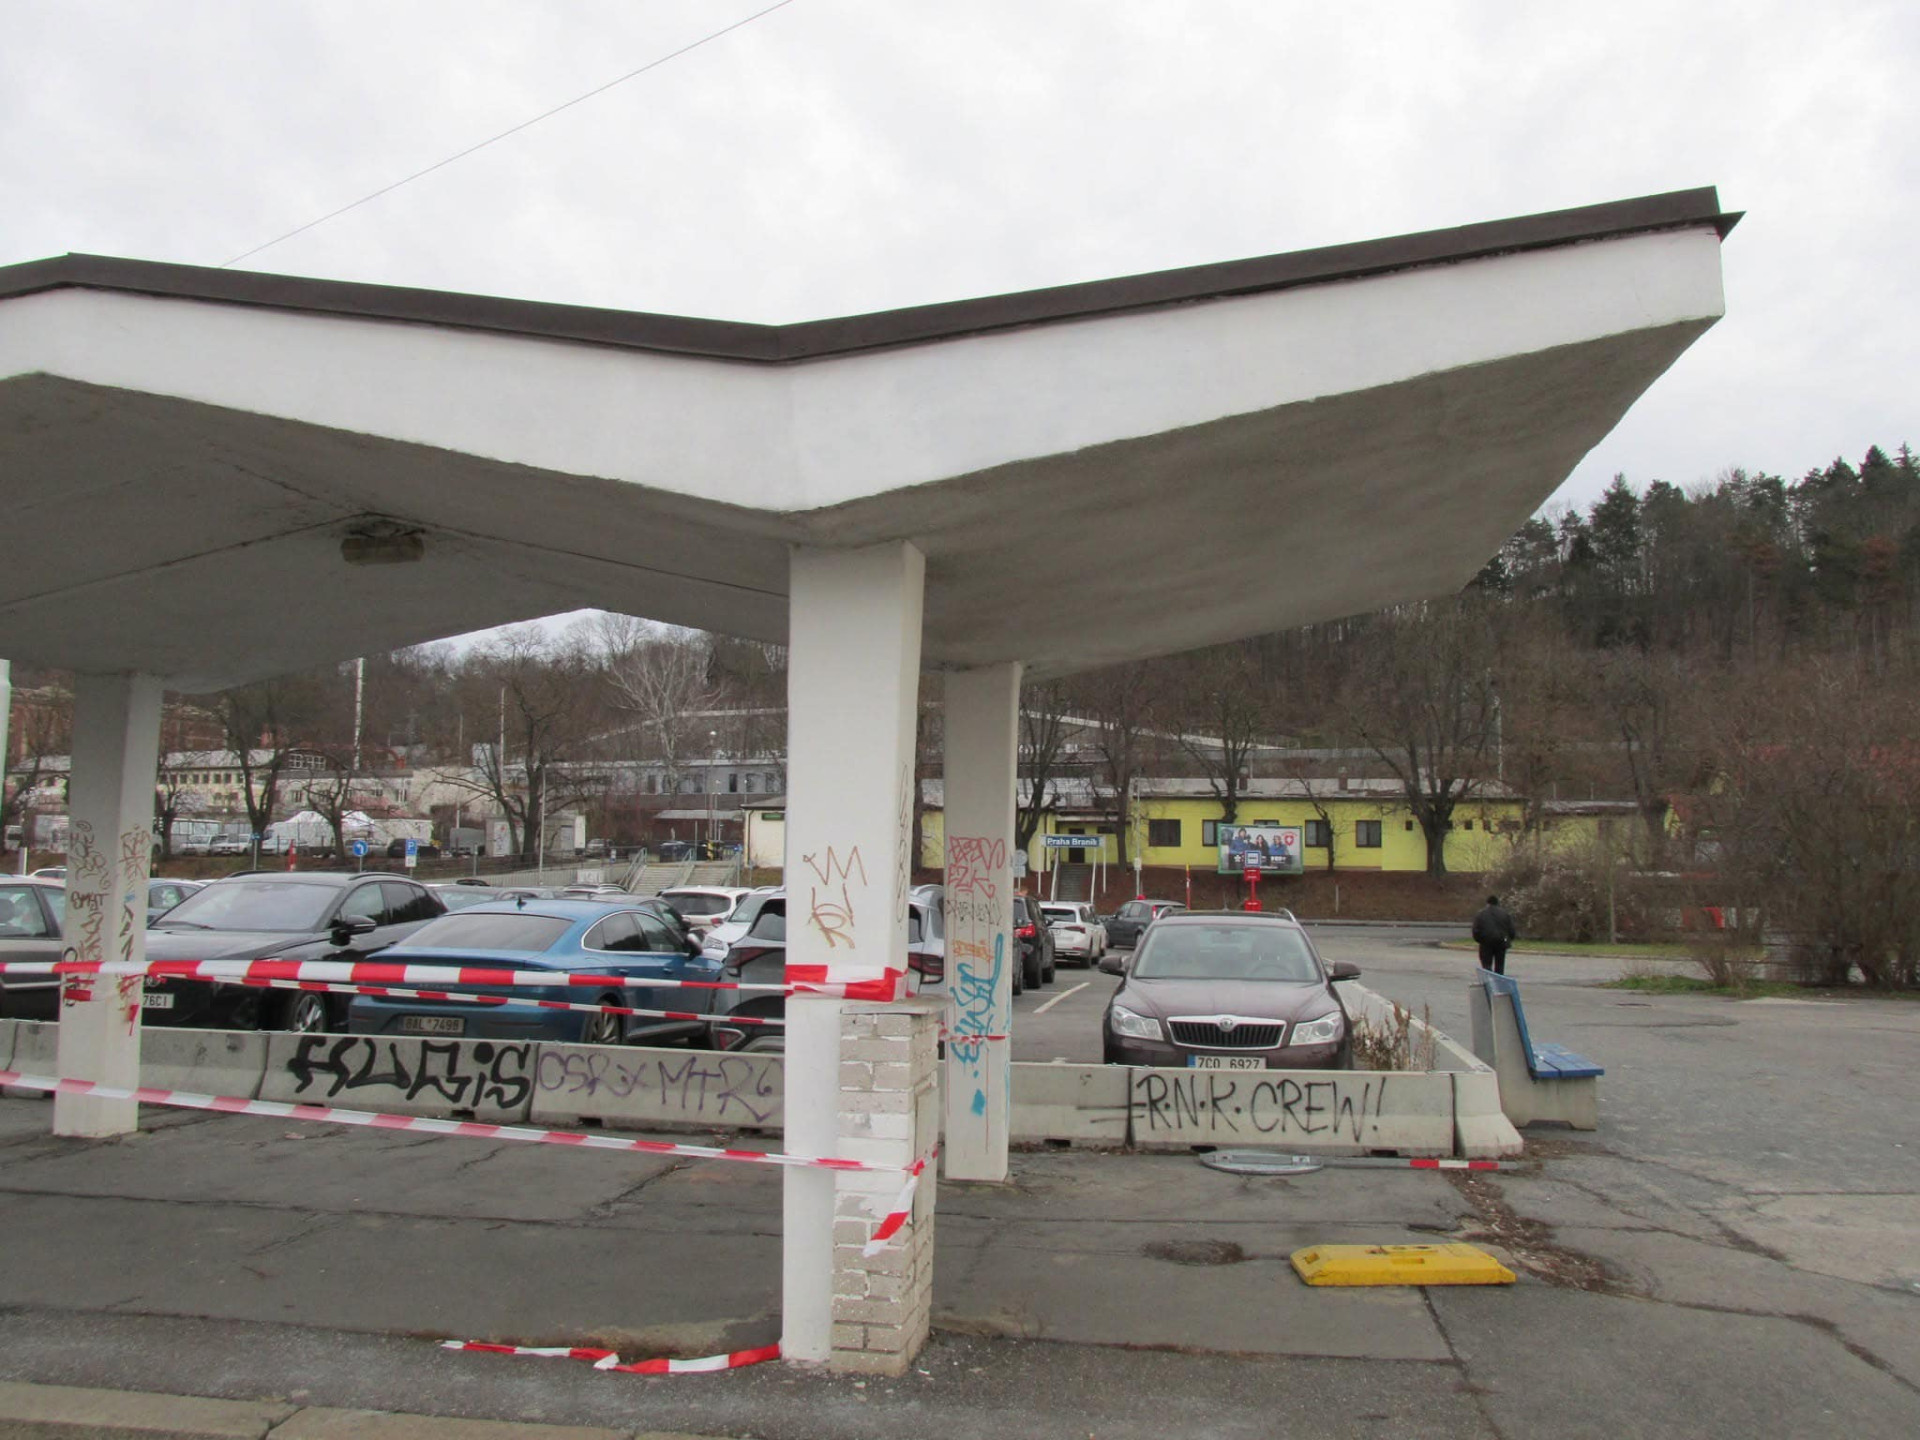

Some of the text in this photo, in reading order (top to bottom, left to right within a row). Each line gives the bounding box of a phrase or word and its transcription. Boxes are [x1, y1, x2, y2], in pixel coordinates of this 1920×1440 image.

[408, 841, 415, 850] P
[1047, 837, 1070, 846] Praha
[1251, 1077, 1386, 1143] CREW!
